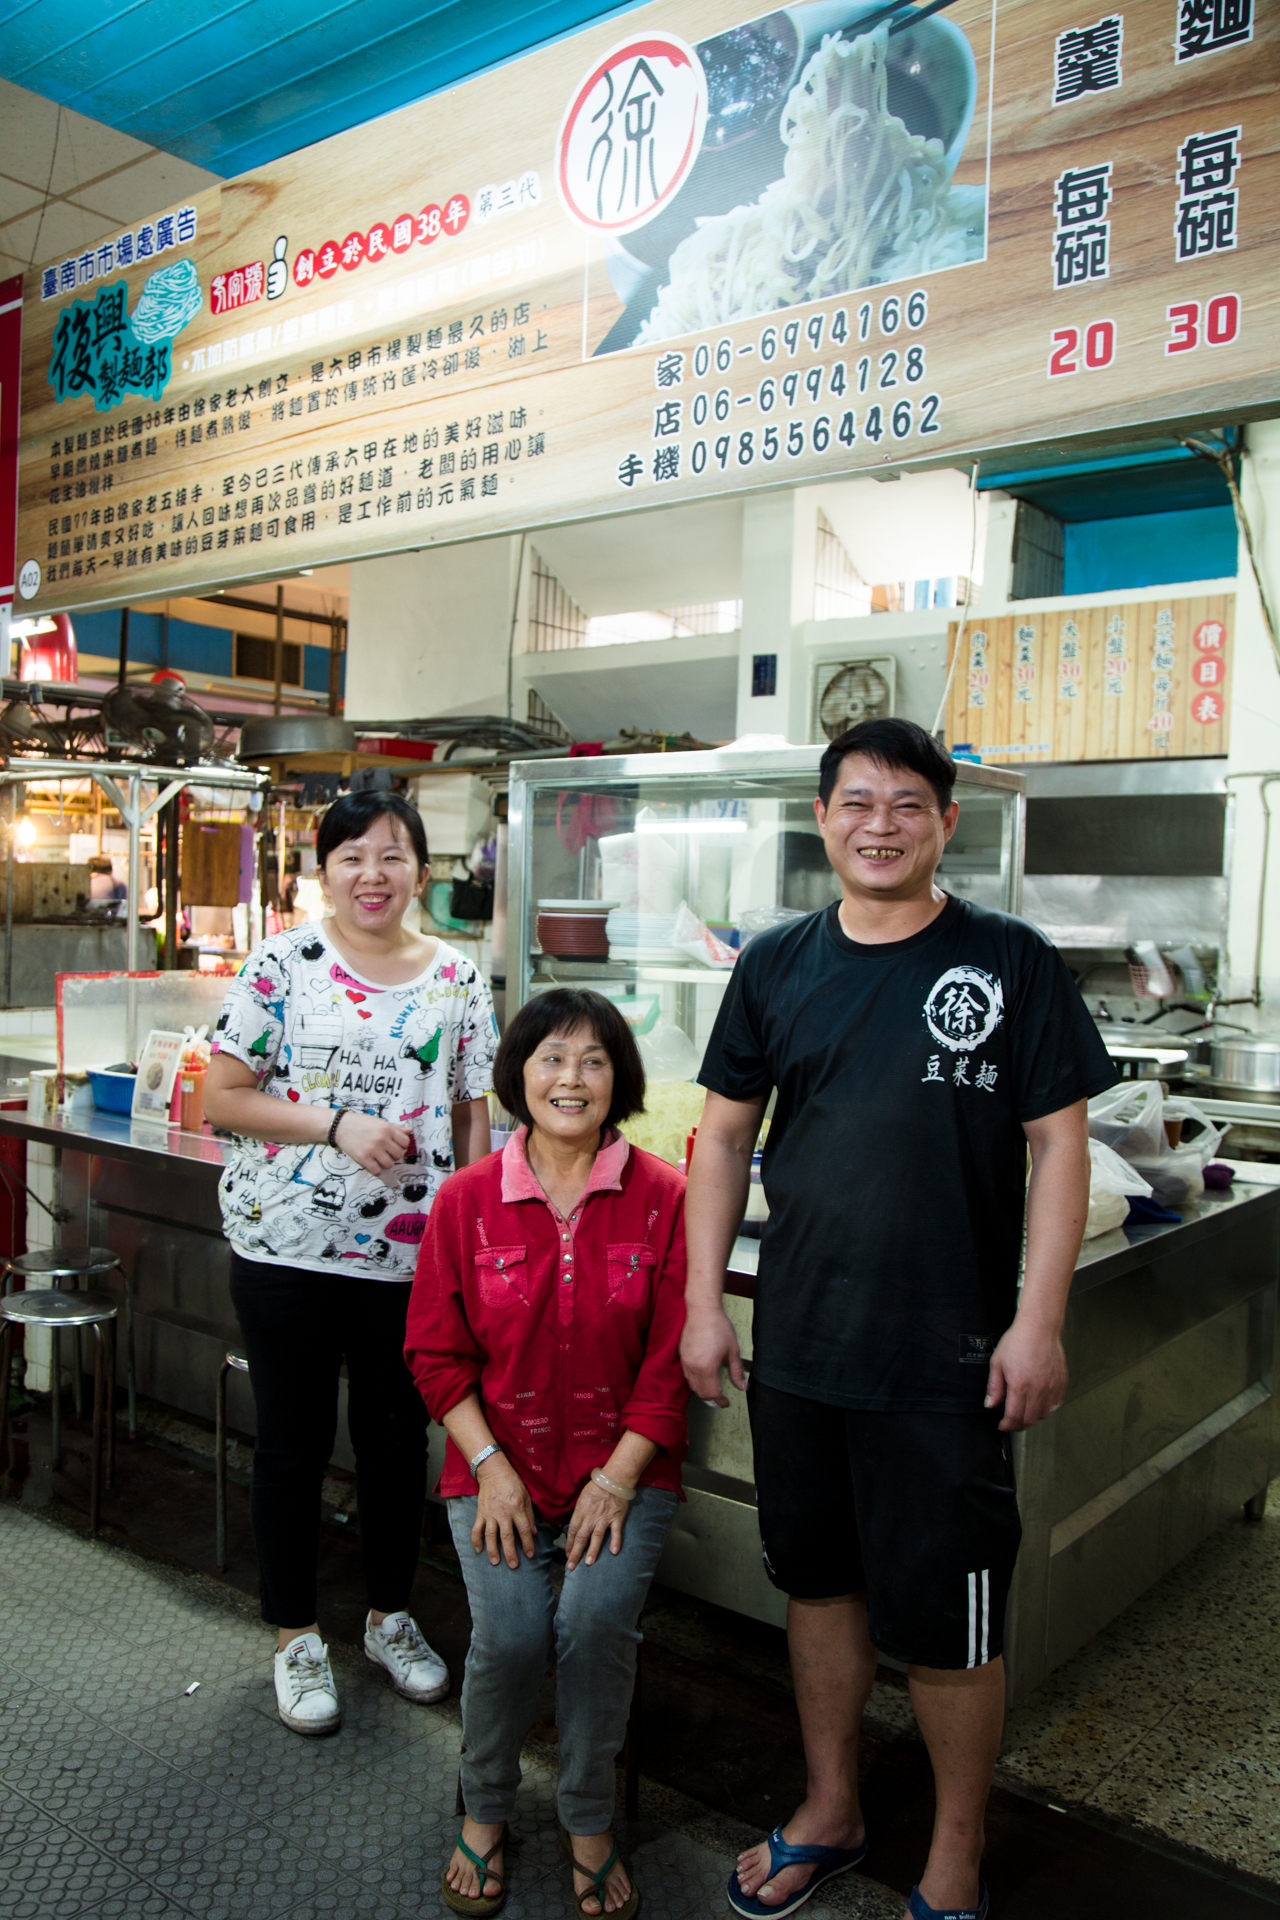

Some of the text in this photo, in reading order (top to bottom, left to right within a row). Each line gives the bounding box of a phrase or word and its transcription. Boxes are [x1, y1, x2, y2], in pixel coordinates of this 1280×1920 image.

[478, 175, 538, 217] 第三代
[1048, 16, 1123, 378] 羹 每碗 20
[1176, 126, 1241, 261] 每碗
[41, 205, 197, 301] 臺南市市場處廣告
[294, 195, 470, 284] 創立於民國38年
[656, 290, 927, 388] 家 06-6994166
[1166, 293, 1241, 355] 30
[98, 345, 169, 404] 製麵部
[654, 345, 926, 438] 店 06-6994128
[617, 394, 941, 486] 手機 0985564462
[21, 571, 39, 588] A02
[968, 630, 990, 708] 肉羹20元
[1014, 624, 1036, 703] 麵羹30元
[1058, 619, 1082, 699] 大盤30元
[1104, 615, 1129, 696] 小盤20元
[1196, 622, 1224, 723] 價目表
[939, 986, 985, 1033] 徐
[340, 1050, 397, 1071] HA HA
[342, 1072, 402, 1097] AAUGH!
[921, 1055, 998, 1092] 豆菜麵
[239, 1169, 258, 1185] HA
[239, 1189, 256, 1207] HA
